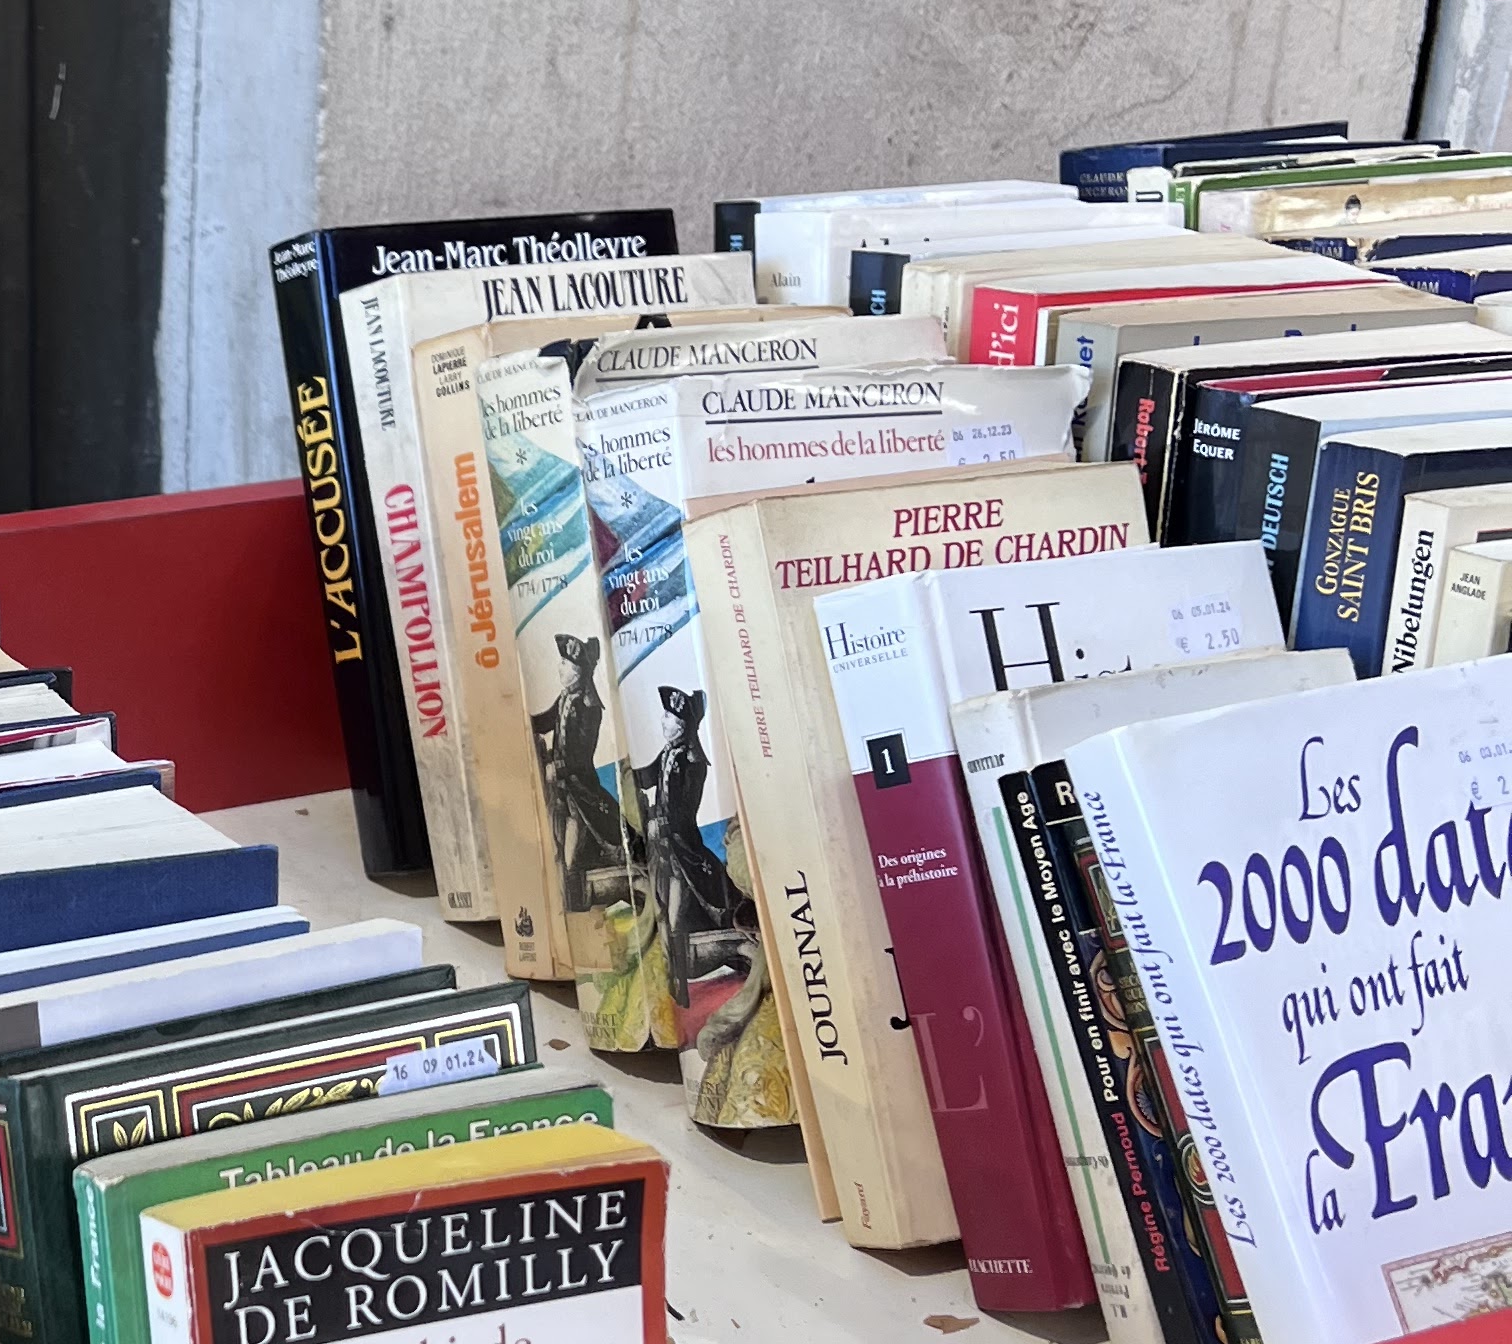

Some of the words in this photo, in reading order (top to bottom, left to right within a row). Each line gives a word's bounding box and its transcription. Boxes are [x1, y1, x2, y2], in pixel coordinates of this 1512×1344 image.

[372, 240, 508, 276] Jean-Marc
[512, 231, 647, 265] Théolleyre
[482, 274, 543, 323] JEAN
[549, 266, 688, 313] LACOUTURE
[769, 272, 801, 288] Alain
[360, 297, 383, 335] JEAN
[432, 357, 467, 375] LAPIERRE
[596, 345, 681, 373] CLAUDE
[689, 338, 818, 367] MANCERON
[369, 339, 396, 432] LACOUTURE
[436, 380, 470, 397] COLLINS
[496, 386, 561, 413] hommes
[610, 394, 668, 417] MANCERON
[702, 388, 796, 415] CLAUDE
[805, 381, 944, 409] MANCERON
[499, 417, 510, 436] la
[512, 407, 564, 432] liberté
[600, 426, 671, 454] hommes
[1193, 419, 1241, 440] JÉRÔME
[603, 459, 616, 479] la
[619, 446, 673, 474] liberté
[708, 437, 734, 462] les
[738, 433, 828, 458] hommes
[831, 431, 856, 456] de
[858, 432, 876, 454] la
[879, 428, 945, 455] liberté
[1193, 440, 1234, 460] EQUER
[296, 374, 363, 664] L'ACCUSÉE
[893, 498, 1004, 538] PIERRE
[1262, 453, 1289, 550] DEUTSCH
[1350, 471, 1380, 535] BRIS
[454, 450, 499, 627] Jérusalem
[507, 522, 536, 544] vingt
[624, 545, 642, 562] les
[1315, 488, 1351, 596] GONZAGUE
[517, 552, 535, 568] du
[536, 548, 554, 565] roi
[719, 533, 741, 600] CHARDIN
[775, 545, 931, 589] TEILHARD
[943, 540, 984, 570] DE
[995, 523, 1130, 565] CHARDIN
[608, 569, 638, 594] vingt
[643, 565, 669, 583] ans
[1338, 538, 1370, 622] SAINT
[1451, 584, 1486, 600] ANGLADE
[1460, 573, 1480, 585] JEAN
[383, 483, 449, 739] CHAMPOLLION
[620, 595, 642, 616] du
[642, 590, 661, 613] roi
[732, 604, 745, 626] DE
[1391, 530, 1434, 673] Nibelungen
[618, 622, 674, 647] 1774/1778
[823, 622, 906, 661] Histoire
[1205, 627, 1239, 649] 2.50
[736, 628, 760, 702] TEILHARD
[833, 647, 908, 674] UNIVERSELLE
[750, 709, 773, 758] PIERRE
[882, 748, 895, 775] 1
[1299, 736, 1361, 821] Les
[1084, 790, 1125, 880] France
[1197, 836, 1352, 965] 2000
[1374, 725, 1512, 928] dat
[878, 853, 899, 869] Des
[900, 847, 946, 867] origines
[885, 872, 895, 887] la
[897, 864, 958, 889] préhistoire
[1030, 836, 1059, 901] Moyen
[1051, 904, 1066, 923] le
[1115, 881, 1138, 907] la
[1059, 929, 1082, 976] avec
[1124, 913, 1173, 964] fait
[784, 870, 847, 1064] JOURNAL
[1140, 961, 1172, 1005] ont
[1073, 979, 1092, 1022] finir
[1282, 961, 1340, 1065] qui
[1350, 953, 1405, 1016] ont
[1408, 929, 1470, 1036] fait
[1086, 1025, 1105, 1051] en
[1156, 1016, 1204, 1057] qui
[393, 1064, 408, 1080] 16
[423, 1059, 437, 1074] 09
[446, 1050, 484, 1071] 01.24
[1096, 1055, 1119, 1103] Pour
[1179, 1063, 1217, 1131] dates
[427, 1129, 454, 1150] la
[1310, 1041, 1512, 1219] Fra
[1111, 1113, 1147, 1197] Pernoud
[1204, 1136, 1235, 1184] 2000
[854, 1181, 872, 1230] Fayard
[1305, 1149, 1346, 1235] la
[86, 1184, 102, 1288] France
[1141, 1201, 1170, 1272] Régine
[1225, 1194, 1257, 1248] Les
[223, 1189, 627, 1309] JACQUELINE
[345, 1239, 623, 1331] ROMILLY
